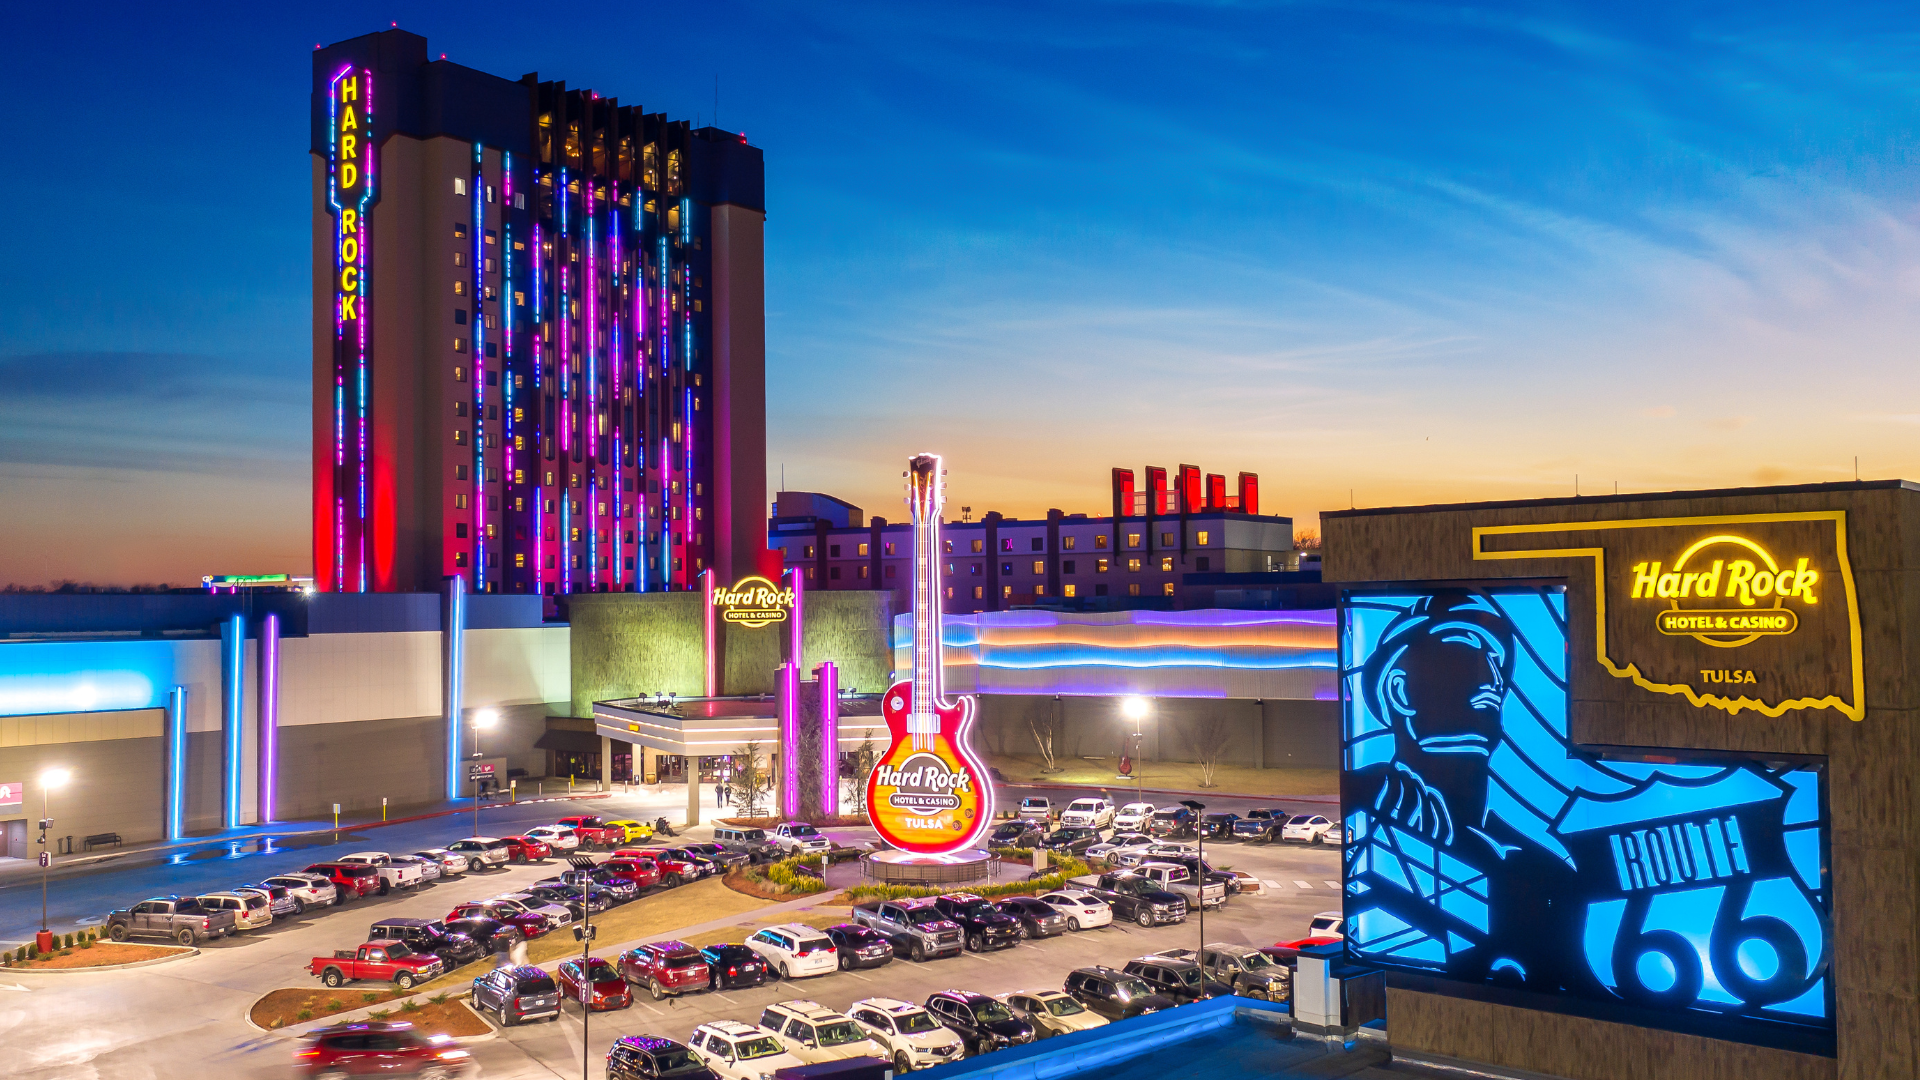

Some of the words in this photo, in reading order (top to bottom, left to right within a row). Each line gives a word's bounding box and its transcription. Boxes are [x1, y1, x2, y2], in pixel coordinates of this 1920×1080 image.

[341, 76, 358, 189] HARD
[341, 208, 358, 321] ROCK
[1631, 559, 1724, 599] Hard
[1726, 557, 1819, 606] Rock
[713, 587, 755, 605] Hard
[755, 586, 795, 608] Rock
[1665, 616, 1714, 629] HOTEL
[1715, 616, 1728, 629] &
[1729, 616, 1787, 629] CASINO
[1700, 669, 1758, 685] TULSA
[877, 764, 924, 787] Hard
[925, 766, 971, 792] Rock
[894, 796, 918, 805] HOTEL
[918, 797, 925, 805] &
[926, 797, 955, 806] CASINO
[905, 817, 943, 829] TULSA
[1612, 817, 1748, 889] ROUTE
[1611, 880, 1810, 1006] 66
